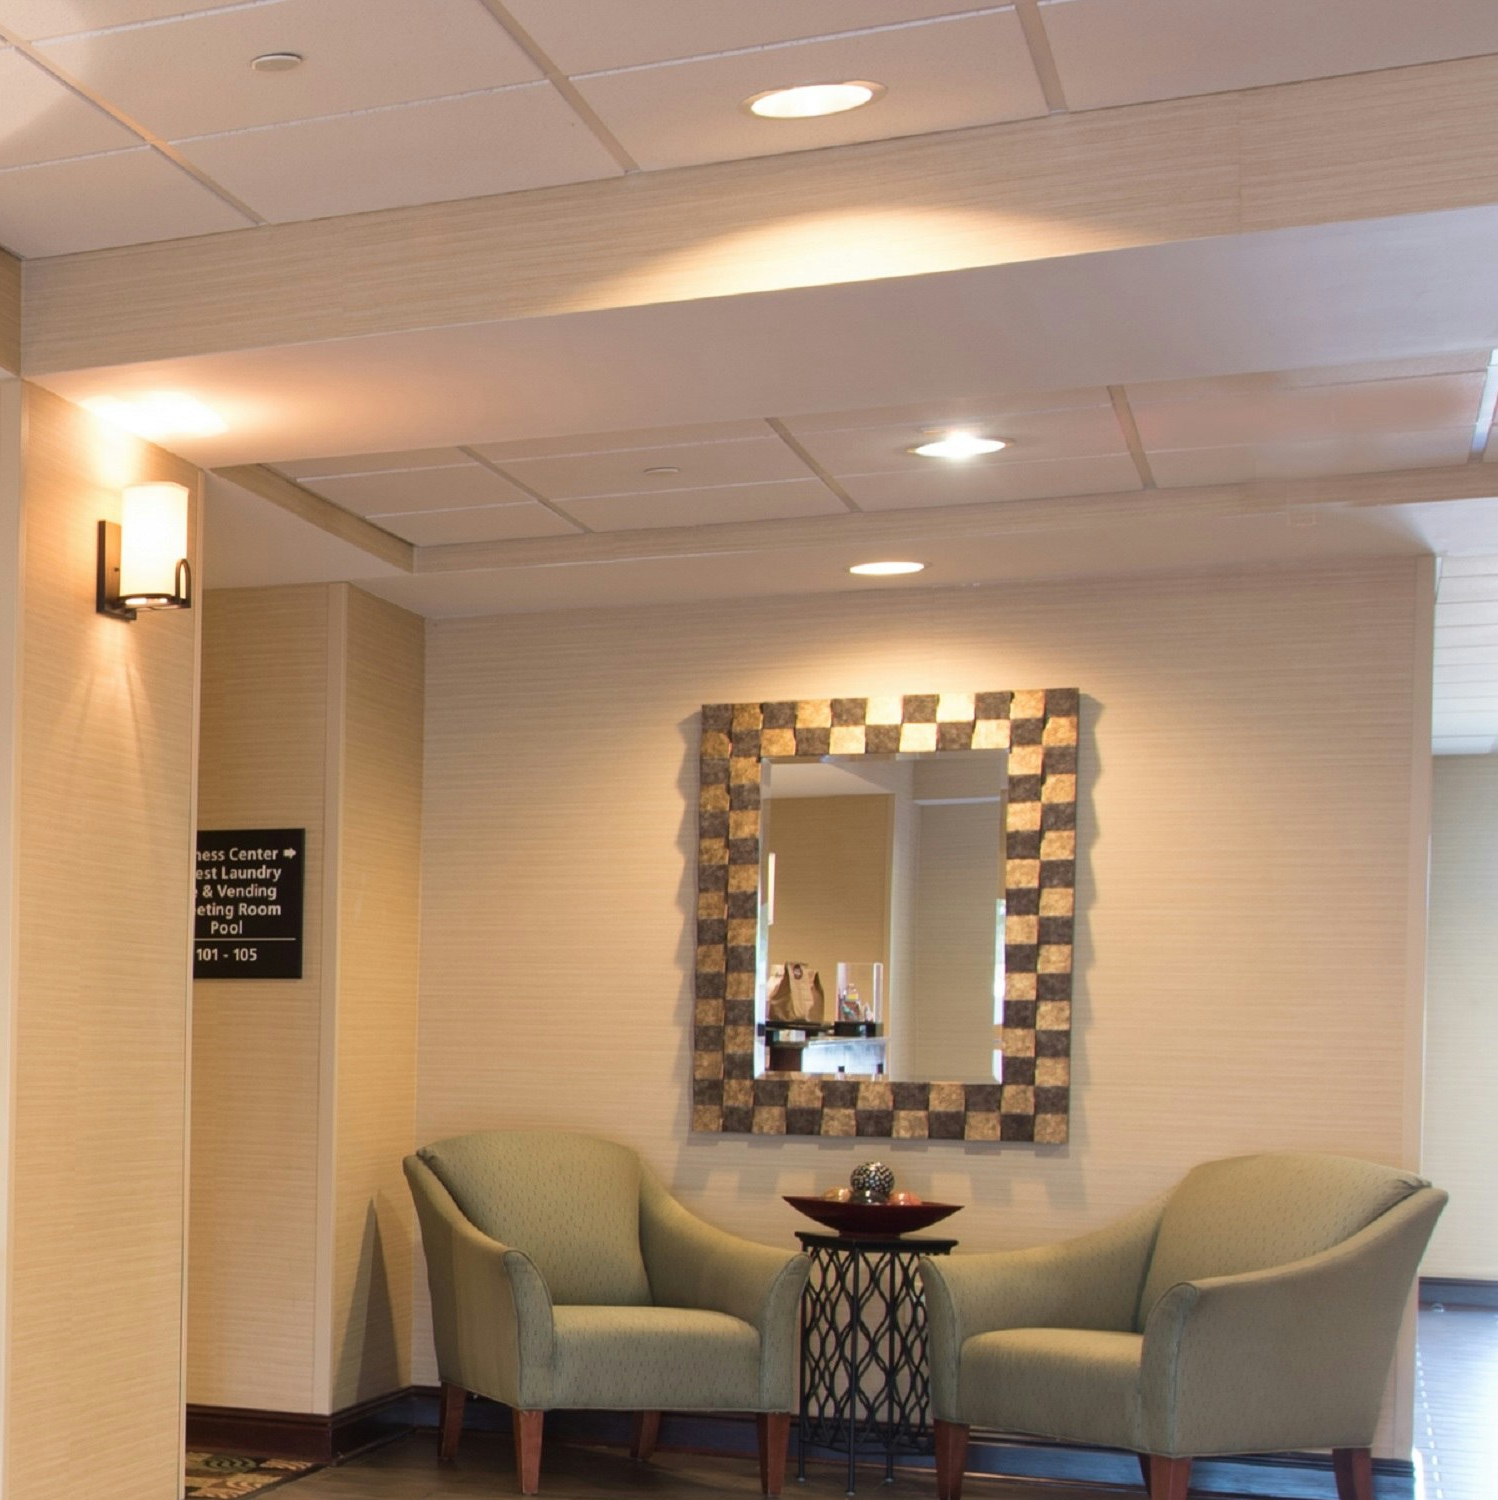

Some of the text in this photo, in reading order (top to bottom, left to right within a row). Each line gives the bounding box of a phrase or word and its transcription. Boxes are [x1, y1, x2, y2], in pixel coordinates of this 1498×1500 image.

[229, 847, 279, 861] Center
[196, 864, 282, 883] est Laundry
[202, 883, 277, 901] & Vending
[195, 903, 282, 920] eting Room
[210, 920, 243, 934] Pool
[196, 948, 219, 961] 101
[233, 948, 257, 961] 105
